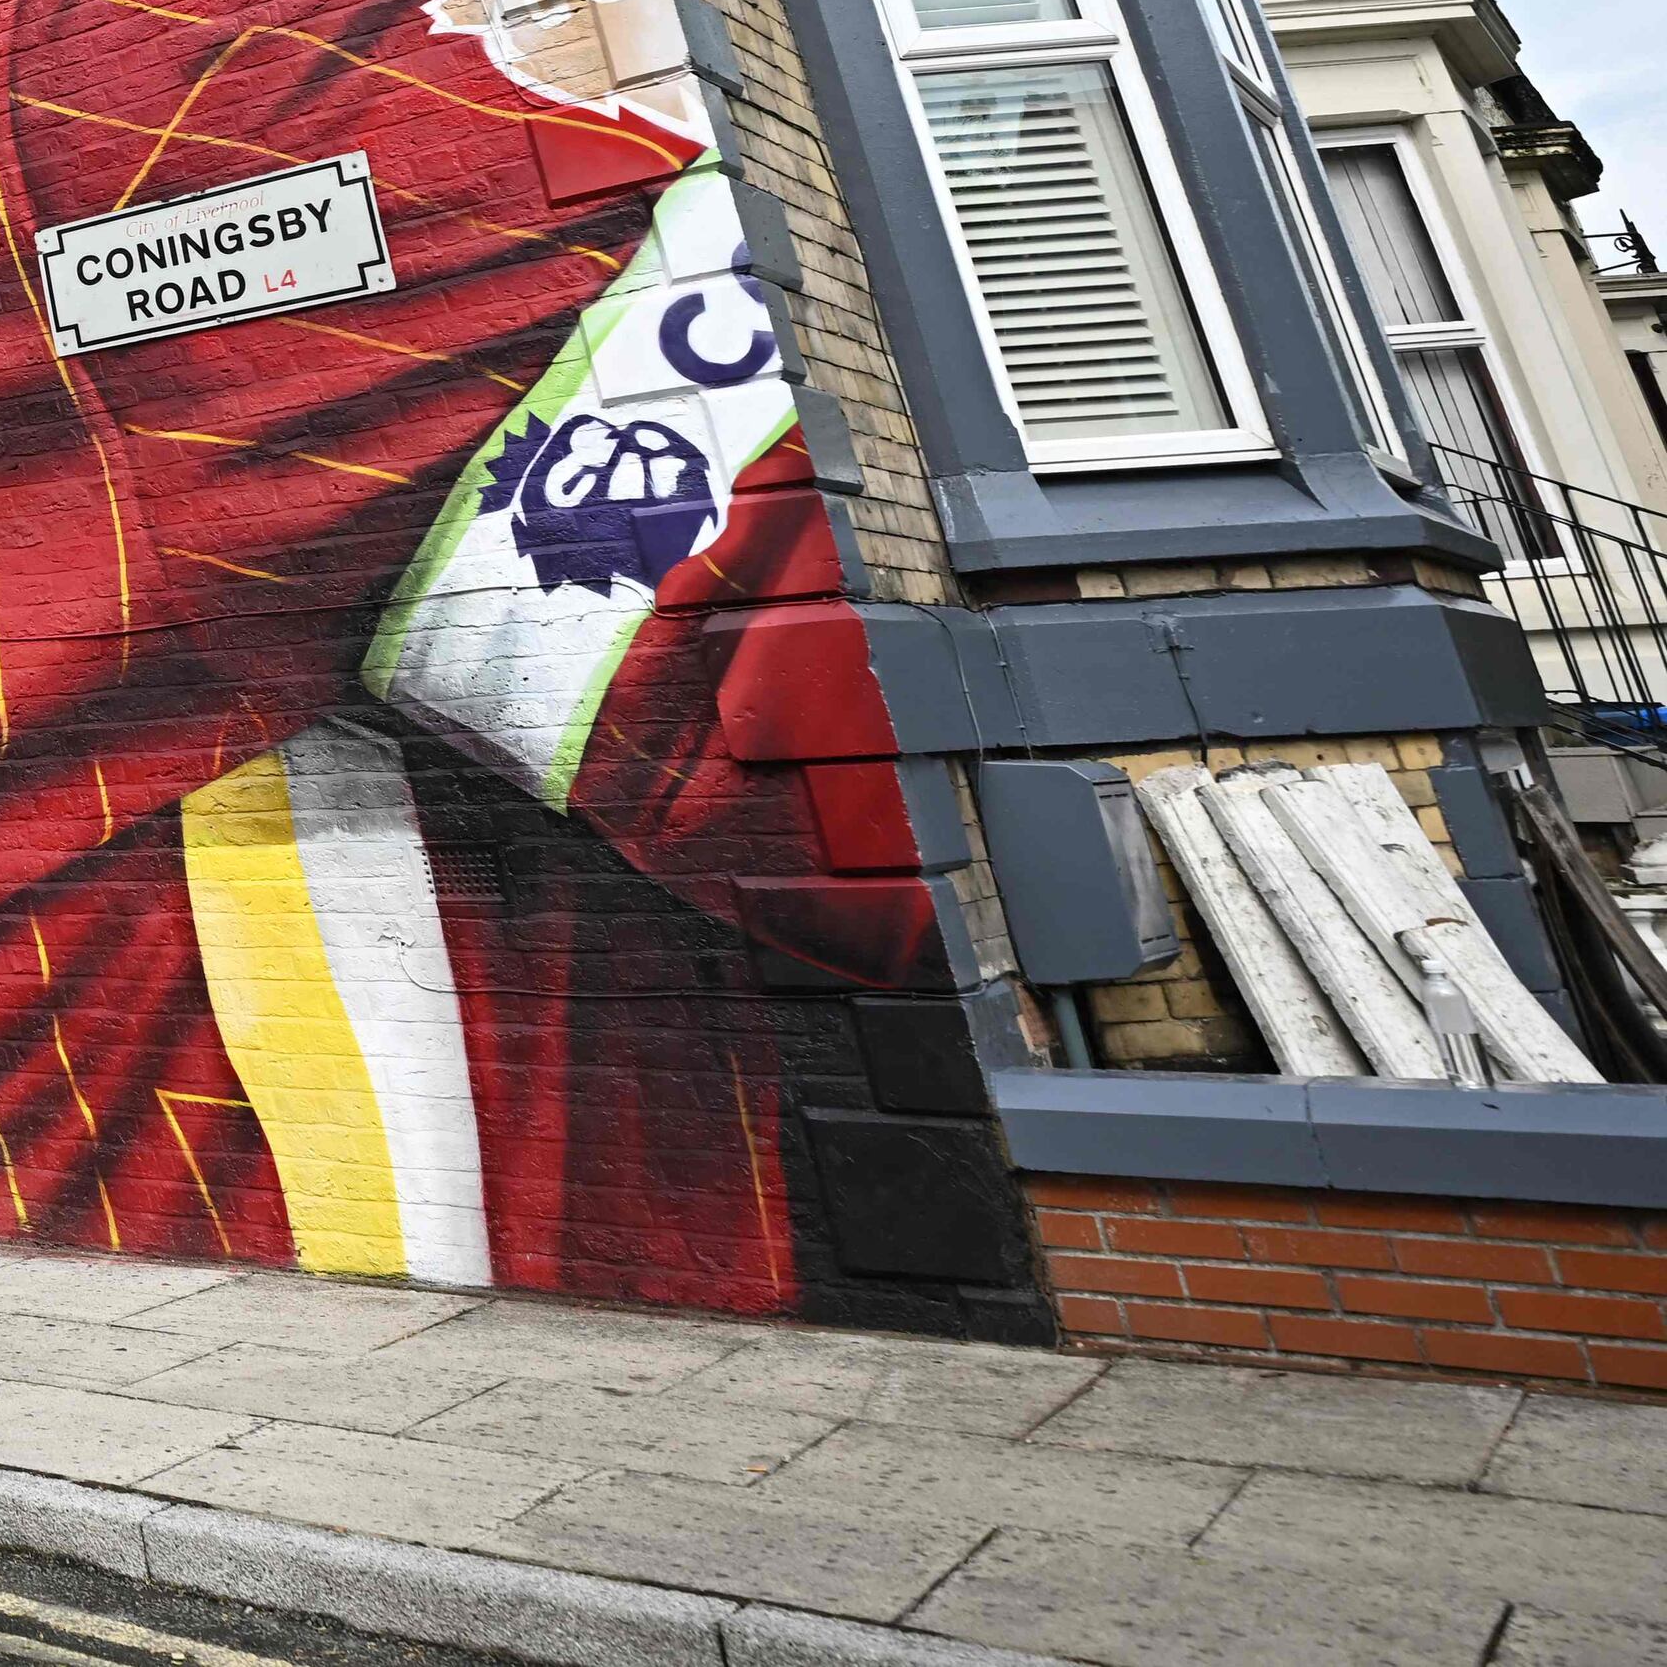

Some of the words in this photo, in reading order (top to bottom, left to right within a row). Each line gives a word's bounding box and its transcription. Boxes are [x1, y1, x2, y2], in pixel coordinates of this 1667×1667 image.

[125, 219, 155, 239] City
[166, 210, 181, 230] of
[185, 191, 266, 225] Liverpool
[76, 198, 333, 286] CONINGSBY
[125, 269, 247, 322] ROAD
[263, 269, 298, 294] L4
